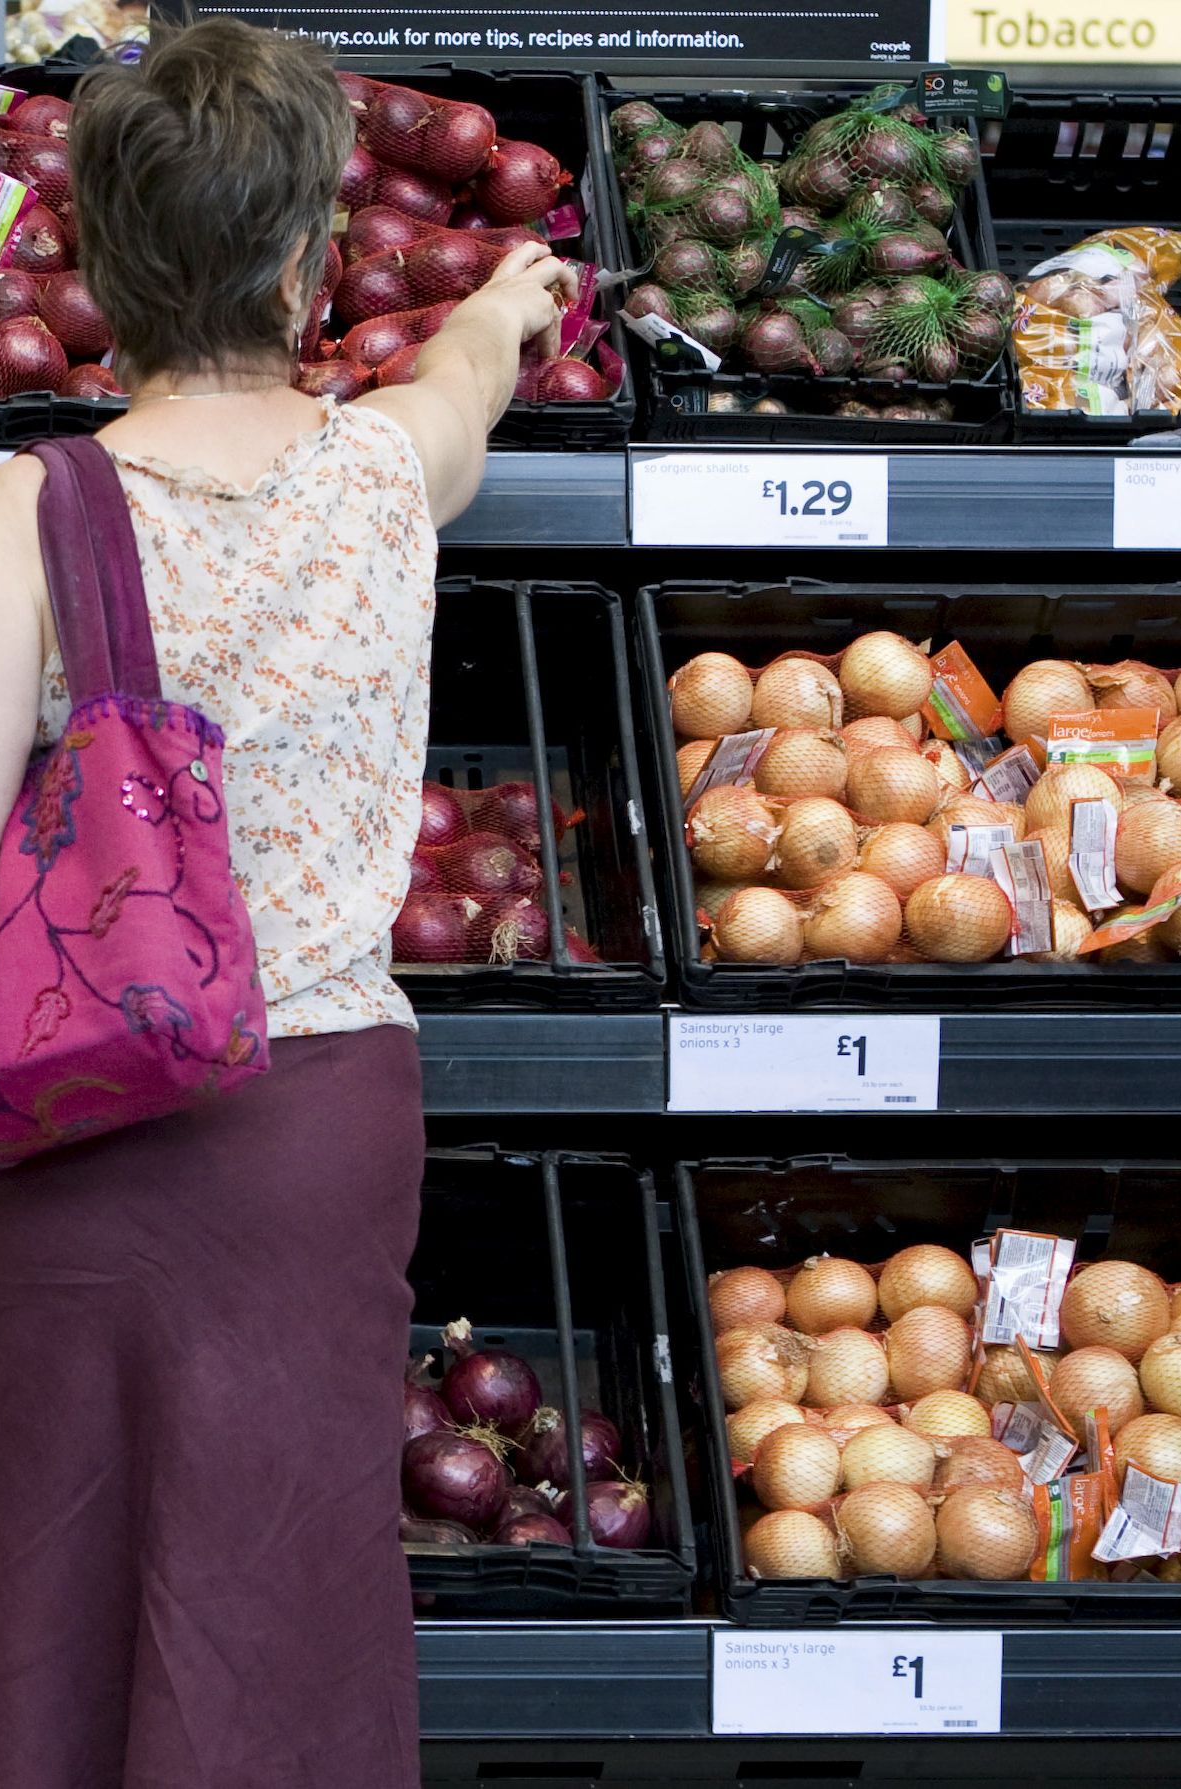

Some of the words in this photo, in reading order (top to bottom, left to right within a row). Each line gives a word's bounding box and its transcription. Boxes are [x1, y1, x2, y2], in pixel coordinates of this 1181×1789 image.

[973, 10, 1156, 48] Tobacco
[284, 27, 398, 48] sburys.co.uk
[405, 28, 429, 45] for
[434, 31, 481, 45] more
[486, 29, 524, 49] tips,
[528, 29, 594, 49] recipes
[597, 31, 631, 47] and
[635, 29, 745, 48] information.
[879, 41, 911, 53] recycle
[953, 87, 978, 96] Onions
[644, 464, 657, 473] so
[660, 463, 703, 475] organic
[706, 463, 750, 473] shallots
[1125, 475, 1156, 487] 400g
[762, 480, 853, 516] £1.29
[1053, 722, 1089, 740] large
[680, 1022, 750, 1036] Sainsbury's
[753, 1022, 784, 1037] large
[679, 1038, 720, 1049] onions
[723, 1040, 730, 1048] x
[732, 1038, 741, 1048] 3
[837, 1034, 867, 1076] £1
[1073, 1479, 1090, 1515] large
[725, 1642, 799, 1656] Sainsbury's
[803, 1642, 836, 1656] large
[725, 1658, 768, 1670] onions
[771, 1660, 778, 1669] x
[781, 1658, 790, 1669] 3
[892, 1655, 924, 1698] £1
